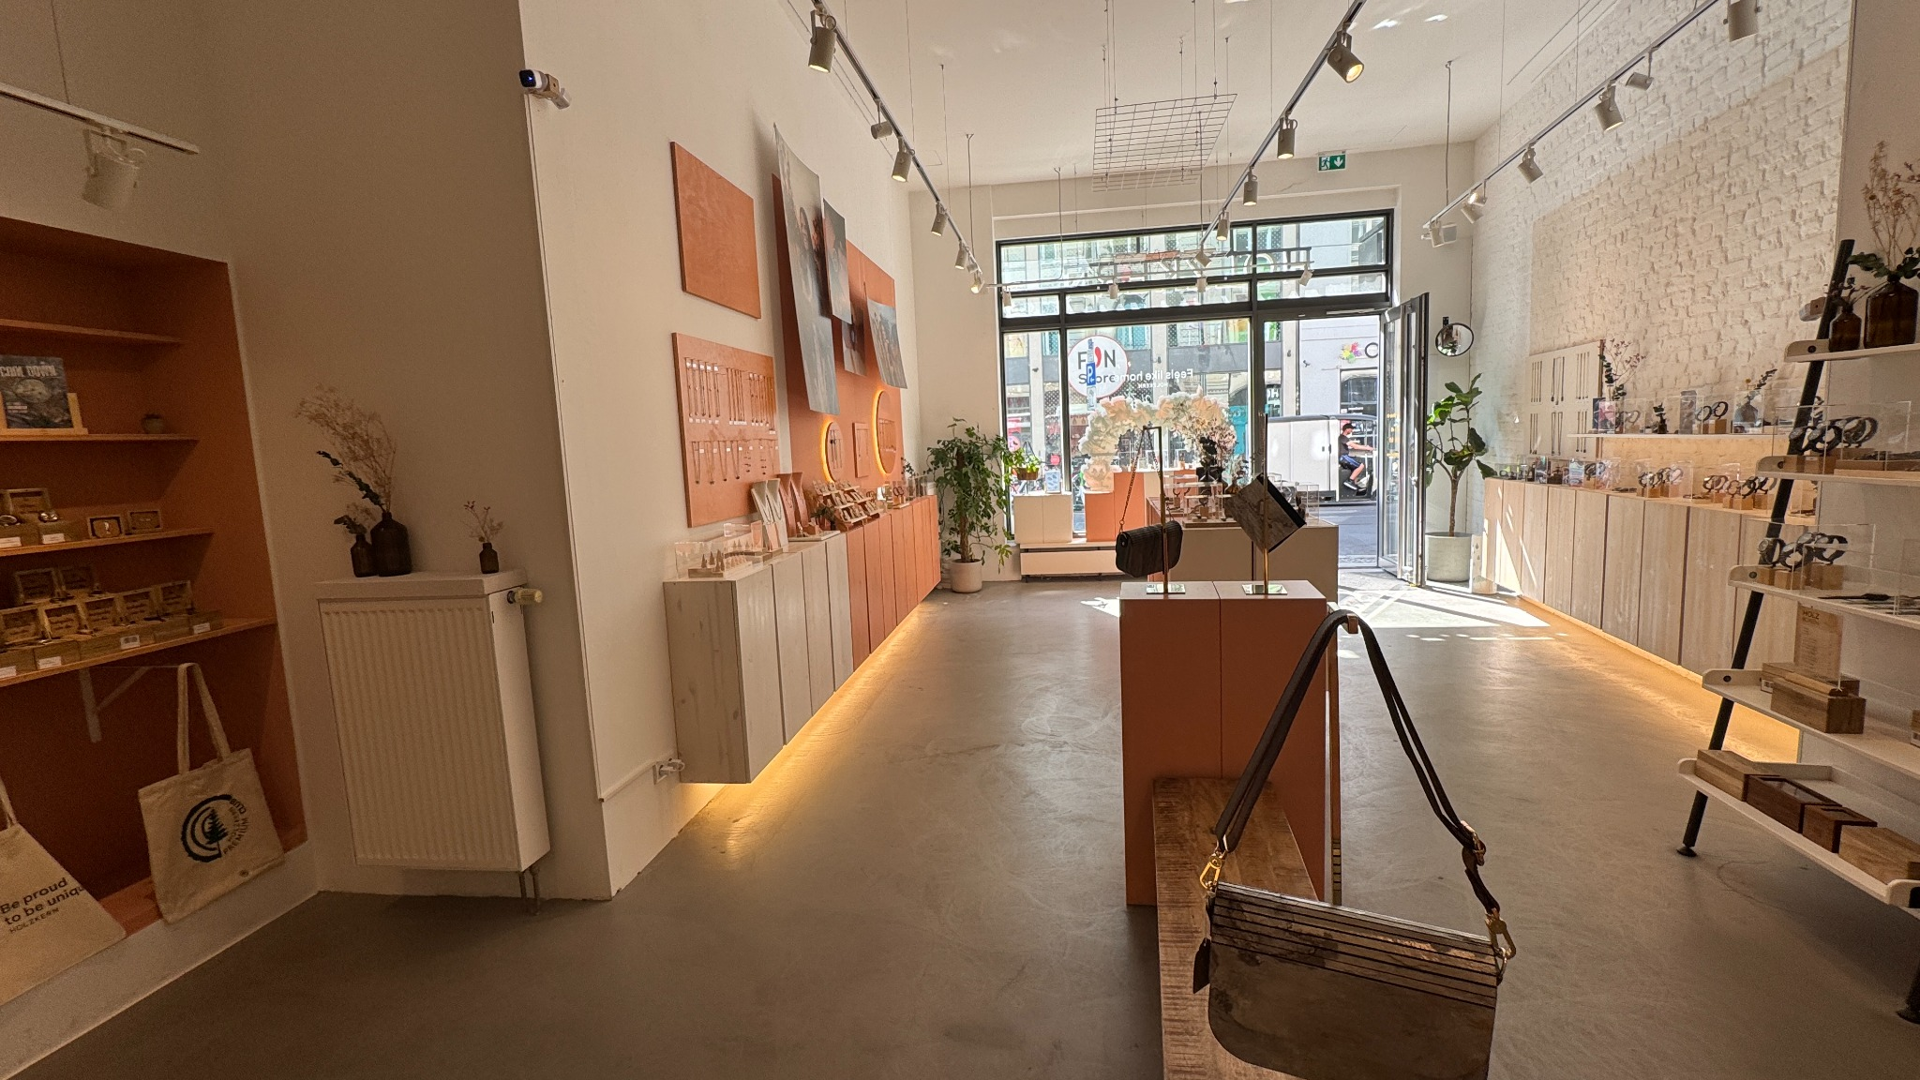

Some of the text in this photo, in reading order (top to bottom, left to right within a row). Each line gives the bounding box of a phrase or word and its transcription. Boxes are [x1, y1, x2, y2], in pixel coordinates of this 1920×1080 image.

[1078, 373, 1116, 385] Sore
[0, 877, 68, 914] Be proud
[4, 914, 21, 925] to
[23, 903, 44, 917] be
[9, 907, 60, 934] HOLZKERN
